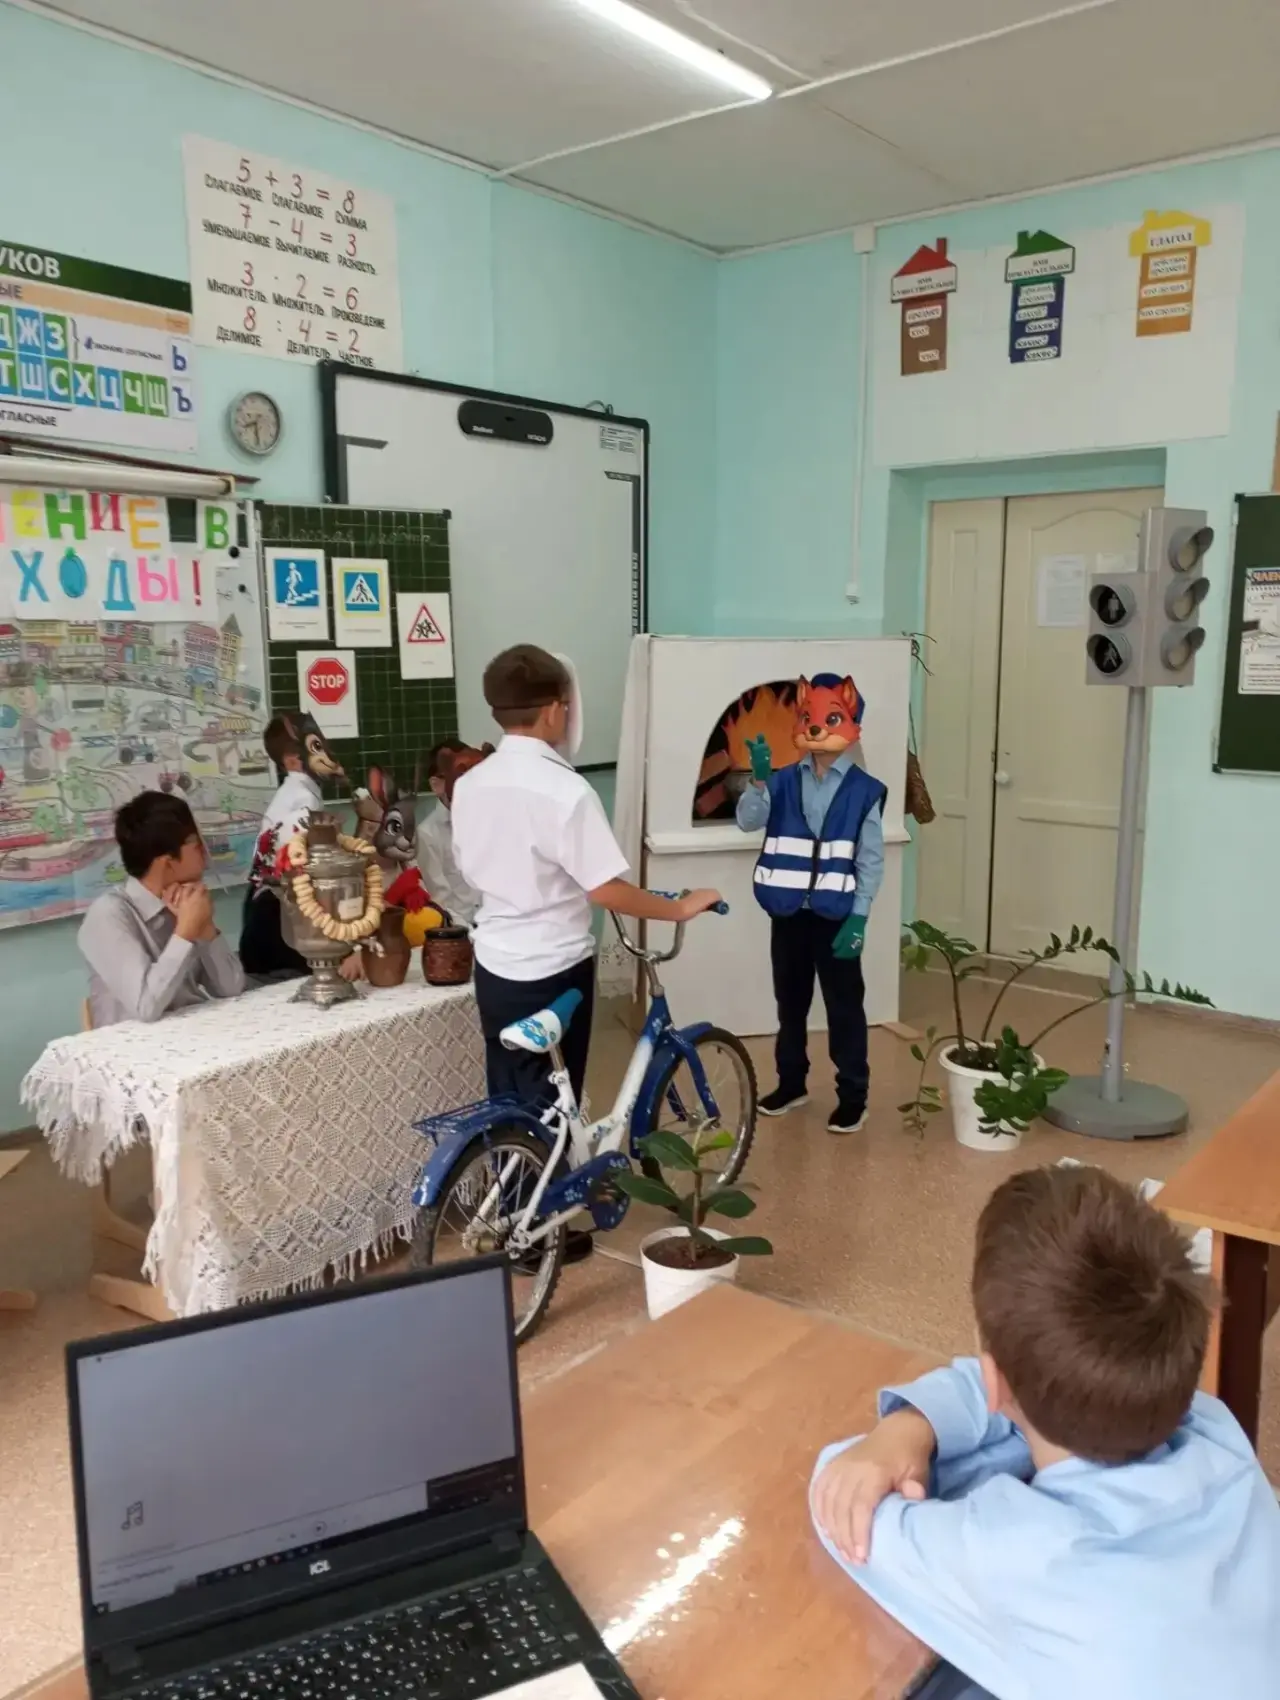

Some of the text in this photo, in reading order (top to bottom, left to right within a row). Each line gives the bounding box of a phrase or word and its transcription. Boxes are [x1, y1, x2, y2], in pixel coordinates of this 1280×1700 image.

[204, 173, 368, 231] СЛАГАЕМОЕ СЛАГАЕМОЕ СУММА
[236, 158, 251, 183] 5
[291, 173, 303, 199] 3
[343, 190, 355, 214] 8
[202, 218, 377, 275] УМЕНЬШАЕМОЕ ВЫЧИТАЕМОЕ РАЗНОСТЬ
[240, 202, 252, 229] 7
[291, 217, 303, 243] 4
[345, 233, 357, 257] 3
[206, 277, 386, 330] МНОЖИТЕЛЬ МНОЖИТЕЛЬ ПРОИЗВЕДЕНИЕ
[240, 261, 255, 287] 3
[296, 273, 307, 300] 2
[346, 286, 360, 311] 6
[216, 325, 375, 369] ДЕЛИМОЕ ДЕЛИТЕЛЬ ЧАСТНОЕ
[243, 305, 256, 332] 8
[299, 319, 312, 343] 4
[348, 328, 361, 353] 2
[0, 408, 57, 427] ГЛАСНЫЕ
[0, 489, 162, 551] ЕНИЕ
[11, 546, 203, 612] ХОДЫ!
[310, 674, 346, 690] STOP
[309, 1559, 331, 1576] ICL
